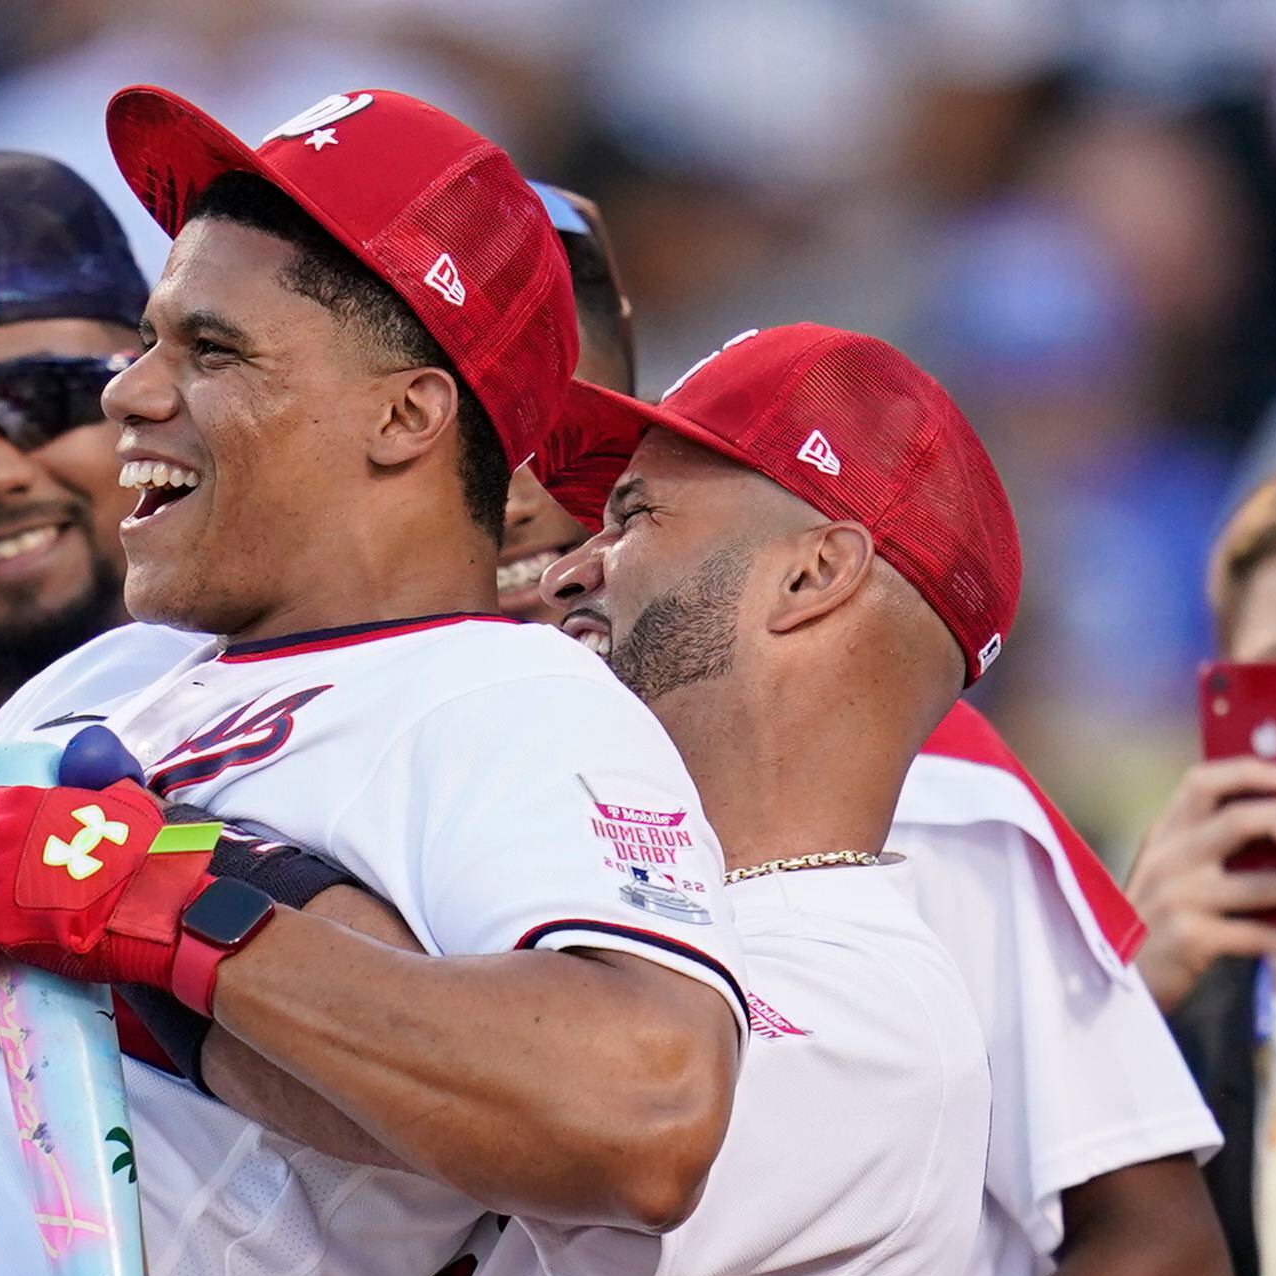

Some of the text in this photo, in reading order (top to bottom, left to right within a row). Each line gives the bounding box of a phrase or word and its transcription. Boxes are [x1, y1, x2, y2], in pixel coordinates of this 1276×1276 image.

[591, 818, 693, 847] HOME RUN
[613, 841, 677, 864] DERBY
[682, 880, 706, 893] 22
